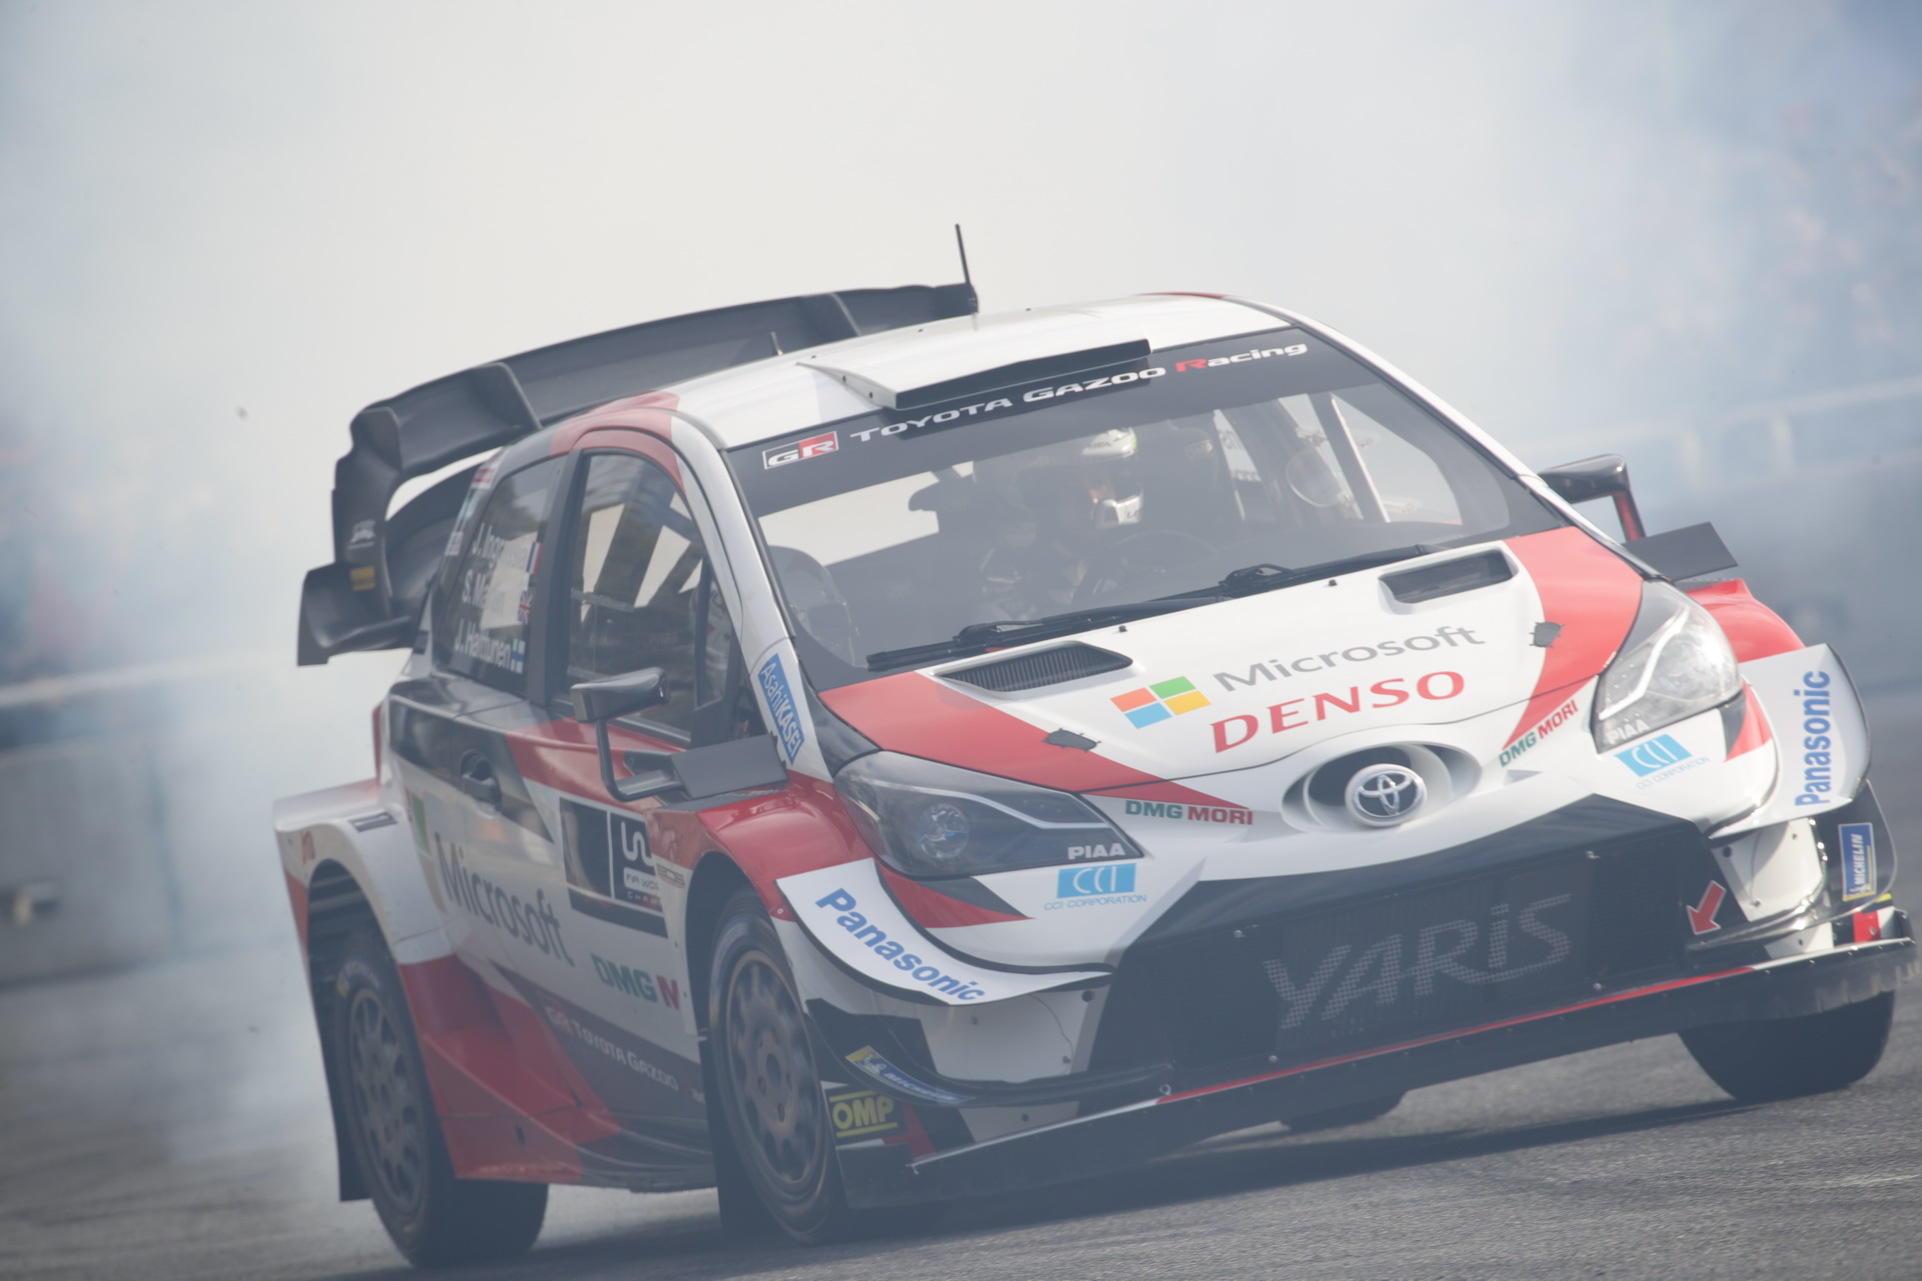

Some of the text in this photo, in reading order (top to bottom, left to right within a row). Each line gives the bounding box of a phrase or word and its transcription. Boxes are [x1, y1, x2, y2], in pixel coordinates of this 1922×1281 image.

[766, 342, 1309, 468] GR TOYOTA GAZOO Racing
[1213, 625, 1486, 692] Microsoft
[1209, 670, 1466, 754] DENSO
[1498, 699, 1579, 768] DMG MORI
[1604, 718, 1652, 746] PIAA
[1793, 670, 1831, 807] Panasonic
[1124, 799, 1254, 826] DMG MORI
[1066, 842, 1126, 861] PIAA
[1850, 833, 1866, 885] MICHELIN
[434, 831, 576, 968] Microsoft
[1066, 894, 1148, 909] CORPORATION
[1072, 864, 1118, 895] CCI
[814, 887, 986, 1002] Panasonic
[590, 952, 659, 1003] DMG
[570, 1018, 628, 1066] TOYOTA
[832, 1095, 895, 1130] OMP
